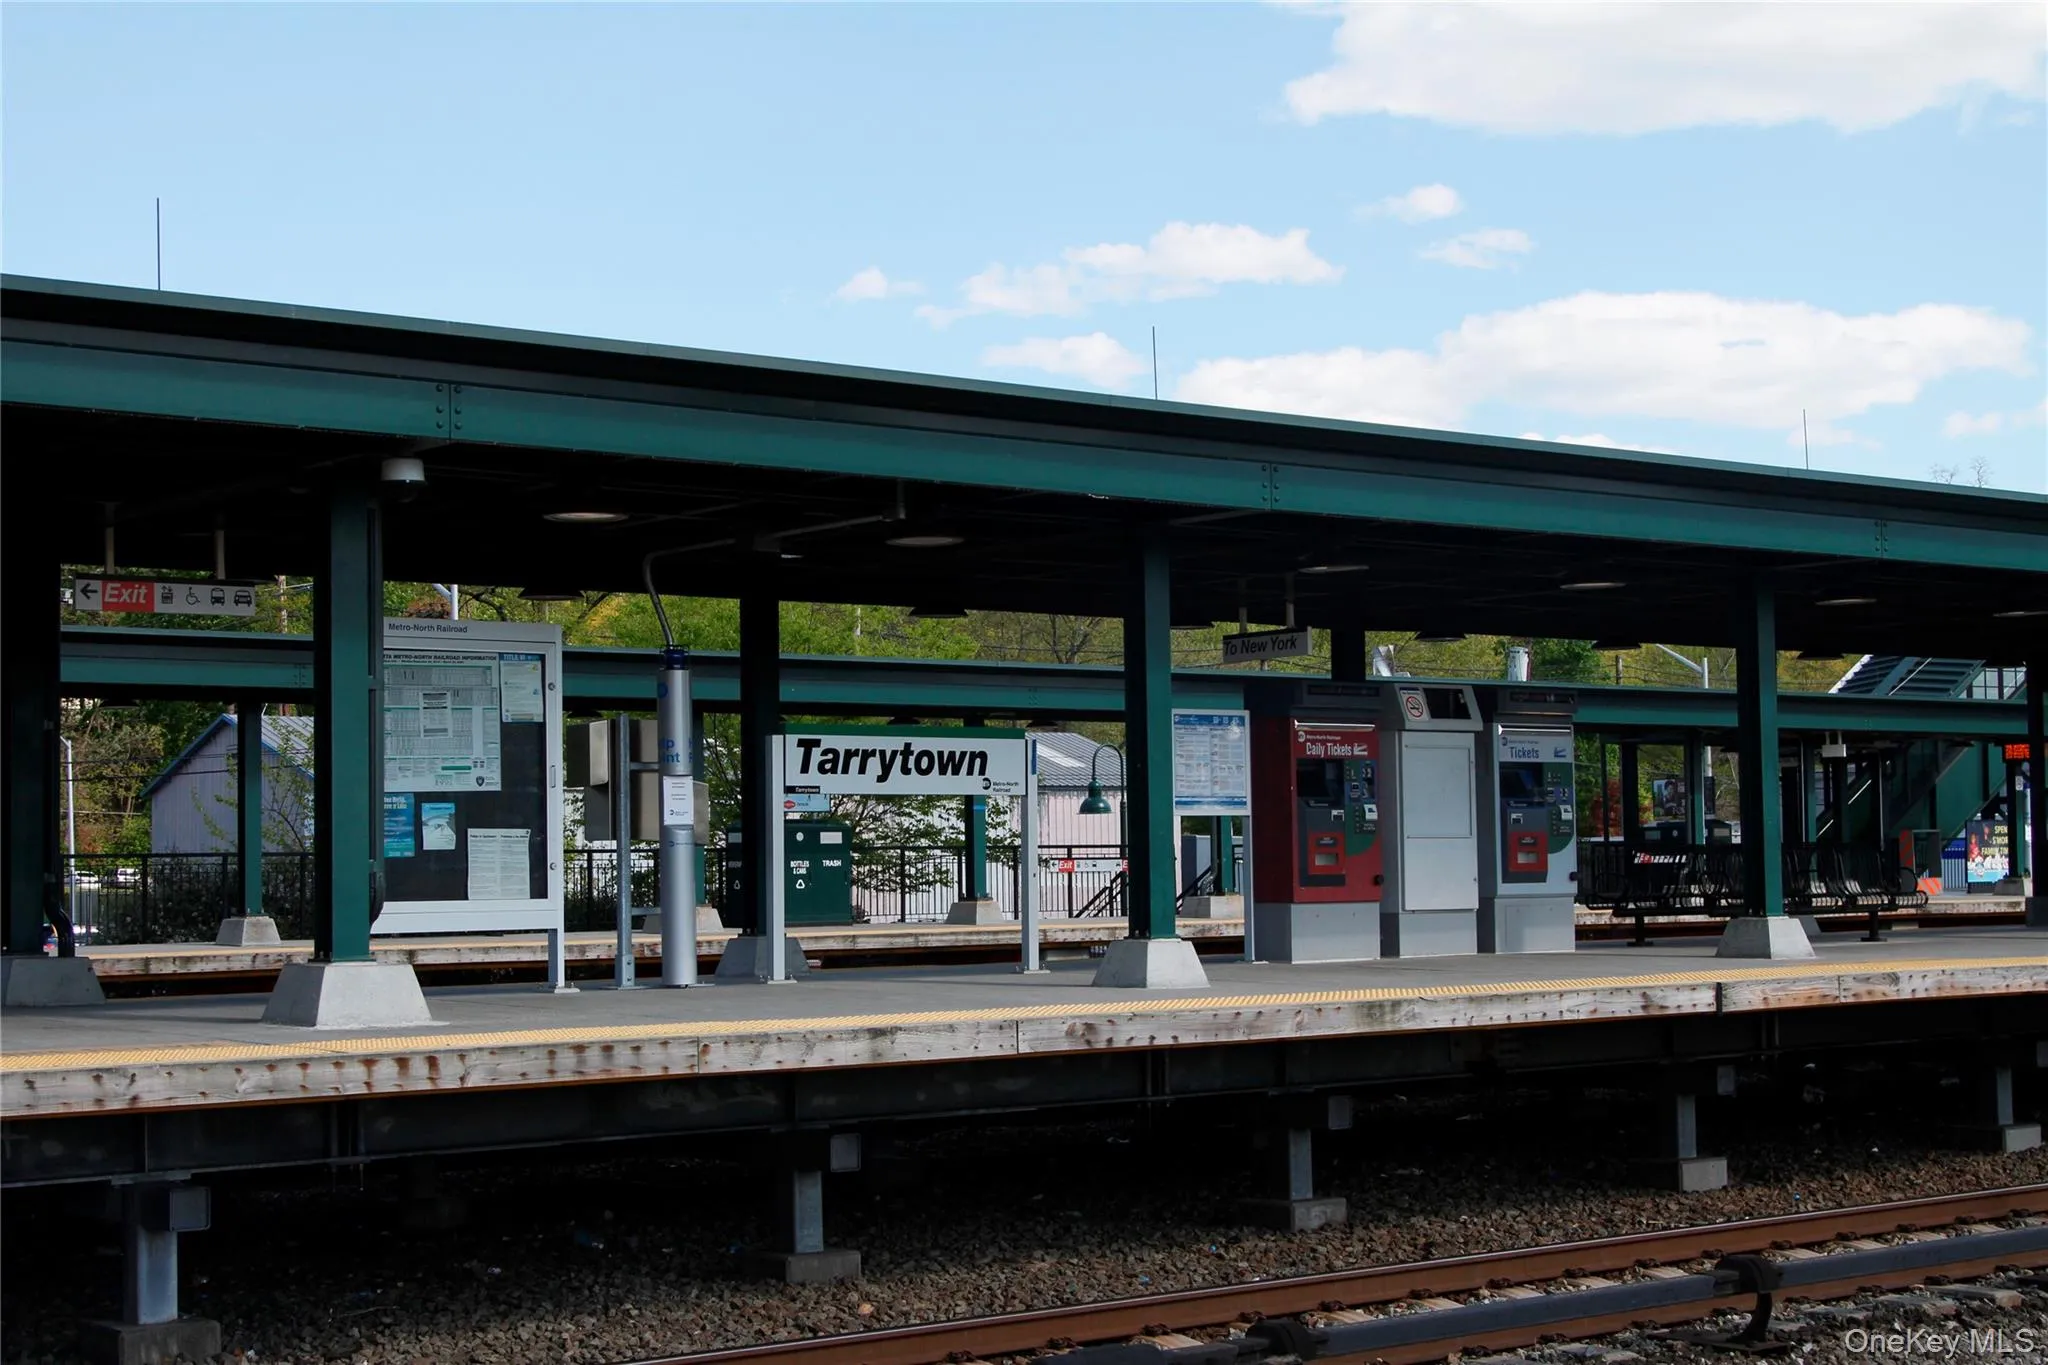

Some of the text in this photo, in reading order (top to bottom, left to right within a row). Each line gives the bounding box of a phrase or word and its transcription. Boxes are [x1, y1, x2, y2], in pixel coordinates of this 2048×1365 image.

[104, 583, 148, 604] Exit
[388, 623, 468, 633] Metro-North Railroad
[1223, 635, 1297, 656] To New York
[1306, 742, 1352, 758] Daily Tickets
[1509, 746, 1540, 759] Tickets
[796, 738, 988, 783] Tarrytown
[790, 860, 809, 868] BOTTLES
[1059, 860, 1073, 869] Exit
